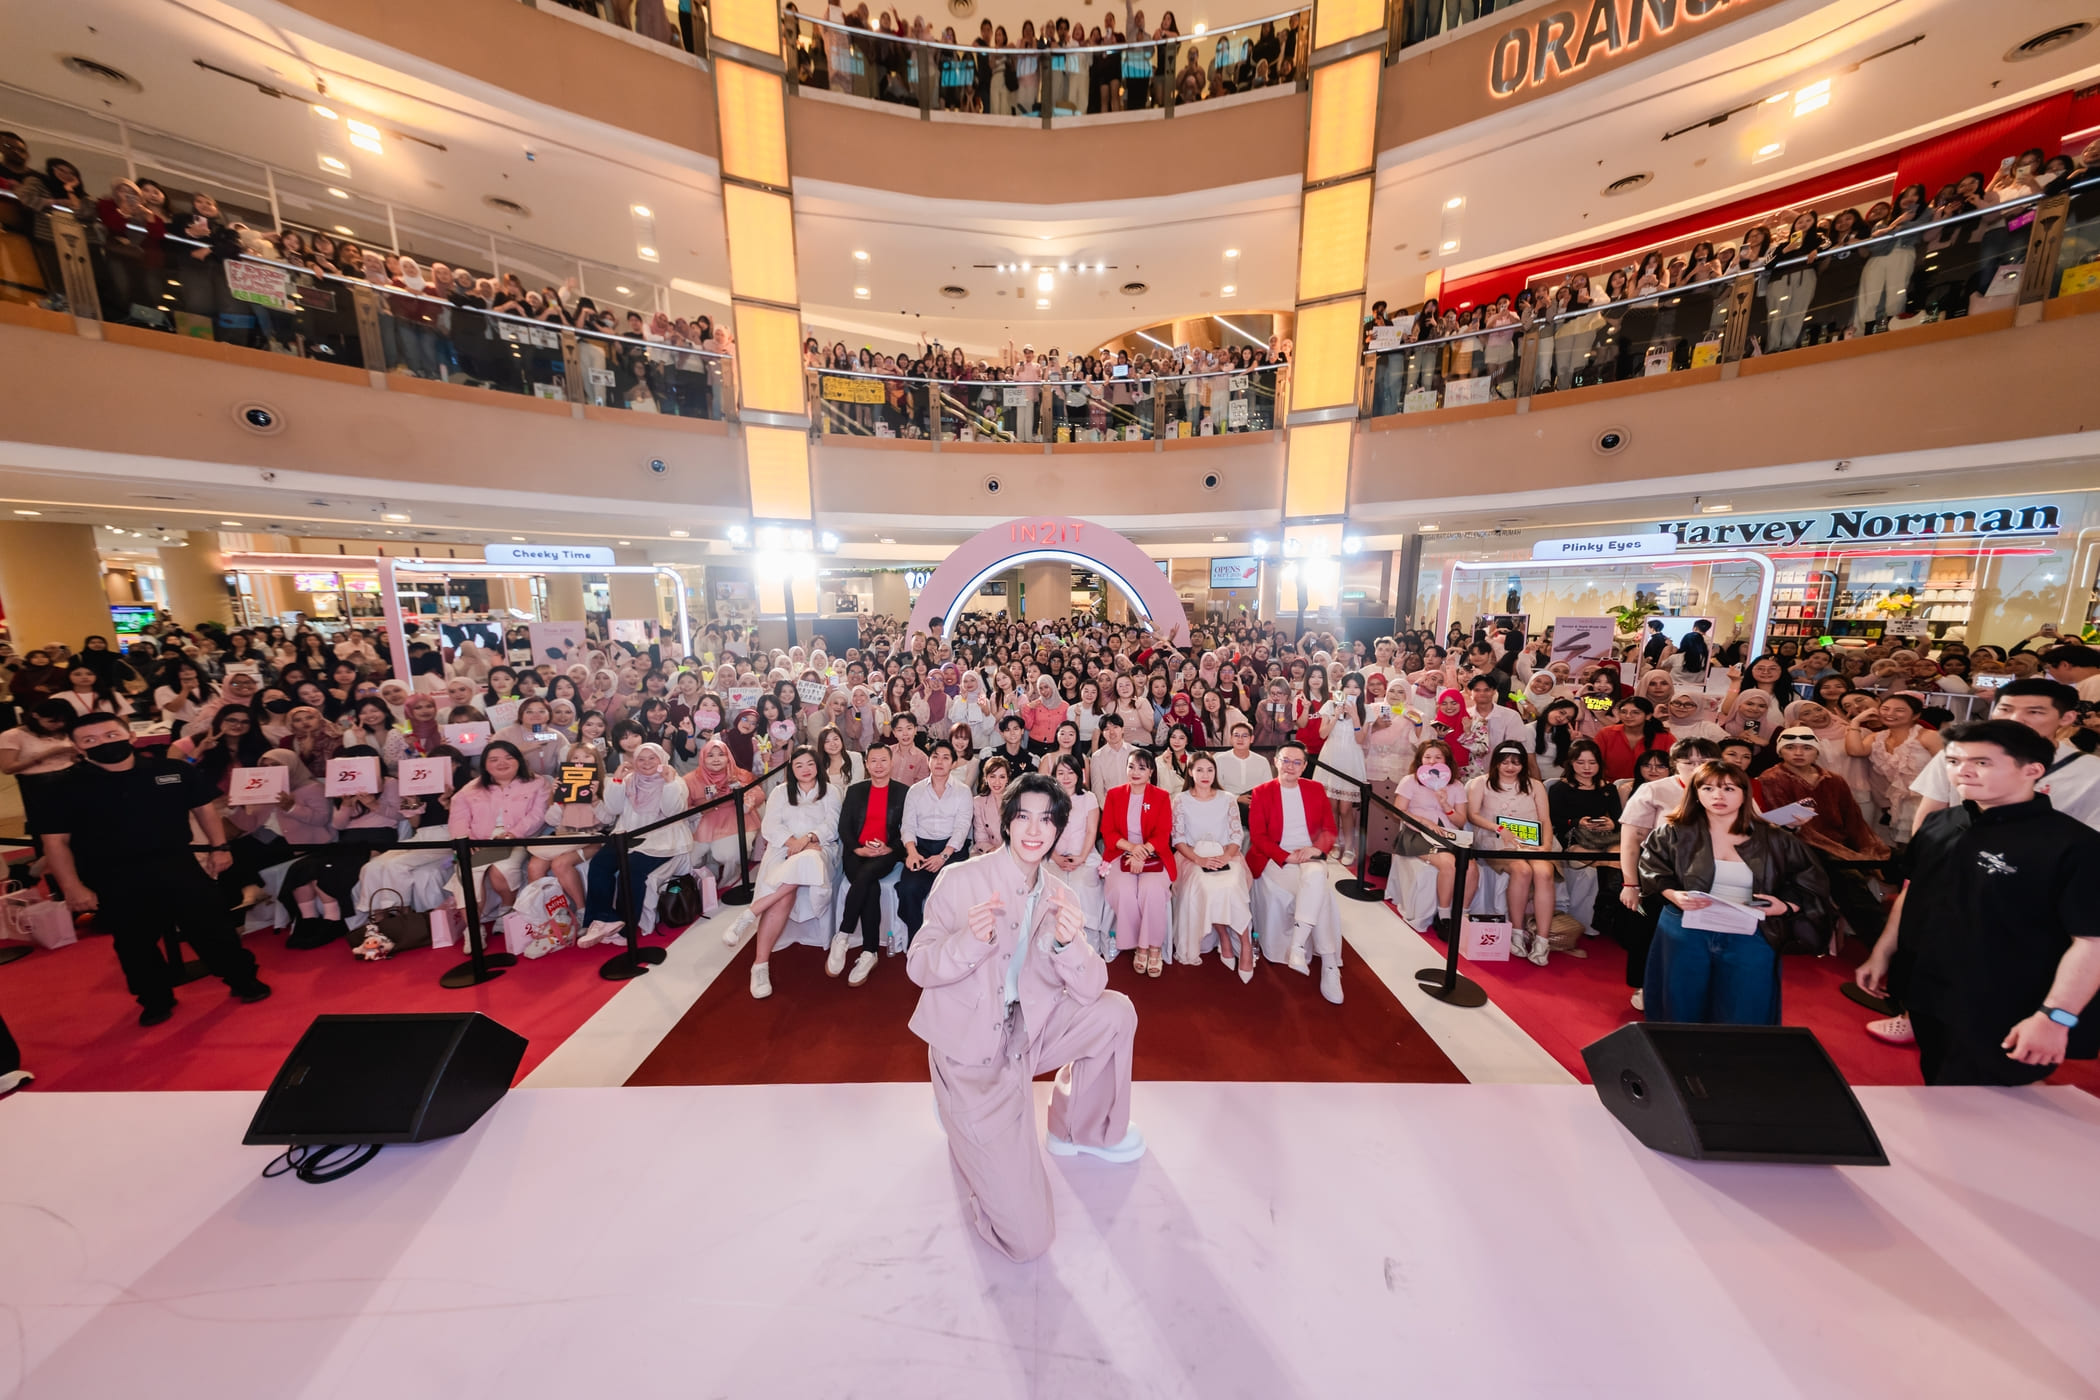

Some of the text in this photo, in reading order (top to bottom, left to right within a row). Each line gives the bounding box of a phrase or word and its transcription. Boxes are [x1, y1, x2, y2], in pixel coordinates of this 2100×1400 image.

[1657, 504, 2061, 546] Harvey Norman
[1010, 521, 1085, 545] IN2IT
[1562, 541, 1642, 552] Plinky Eyes
[512, 549, 591, 560] Cheeky Time
[1214, 565, 1241, 574] OPENS
[1308, 711, 1321, 720] adi
